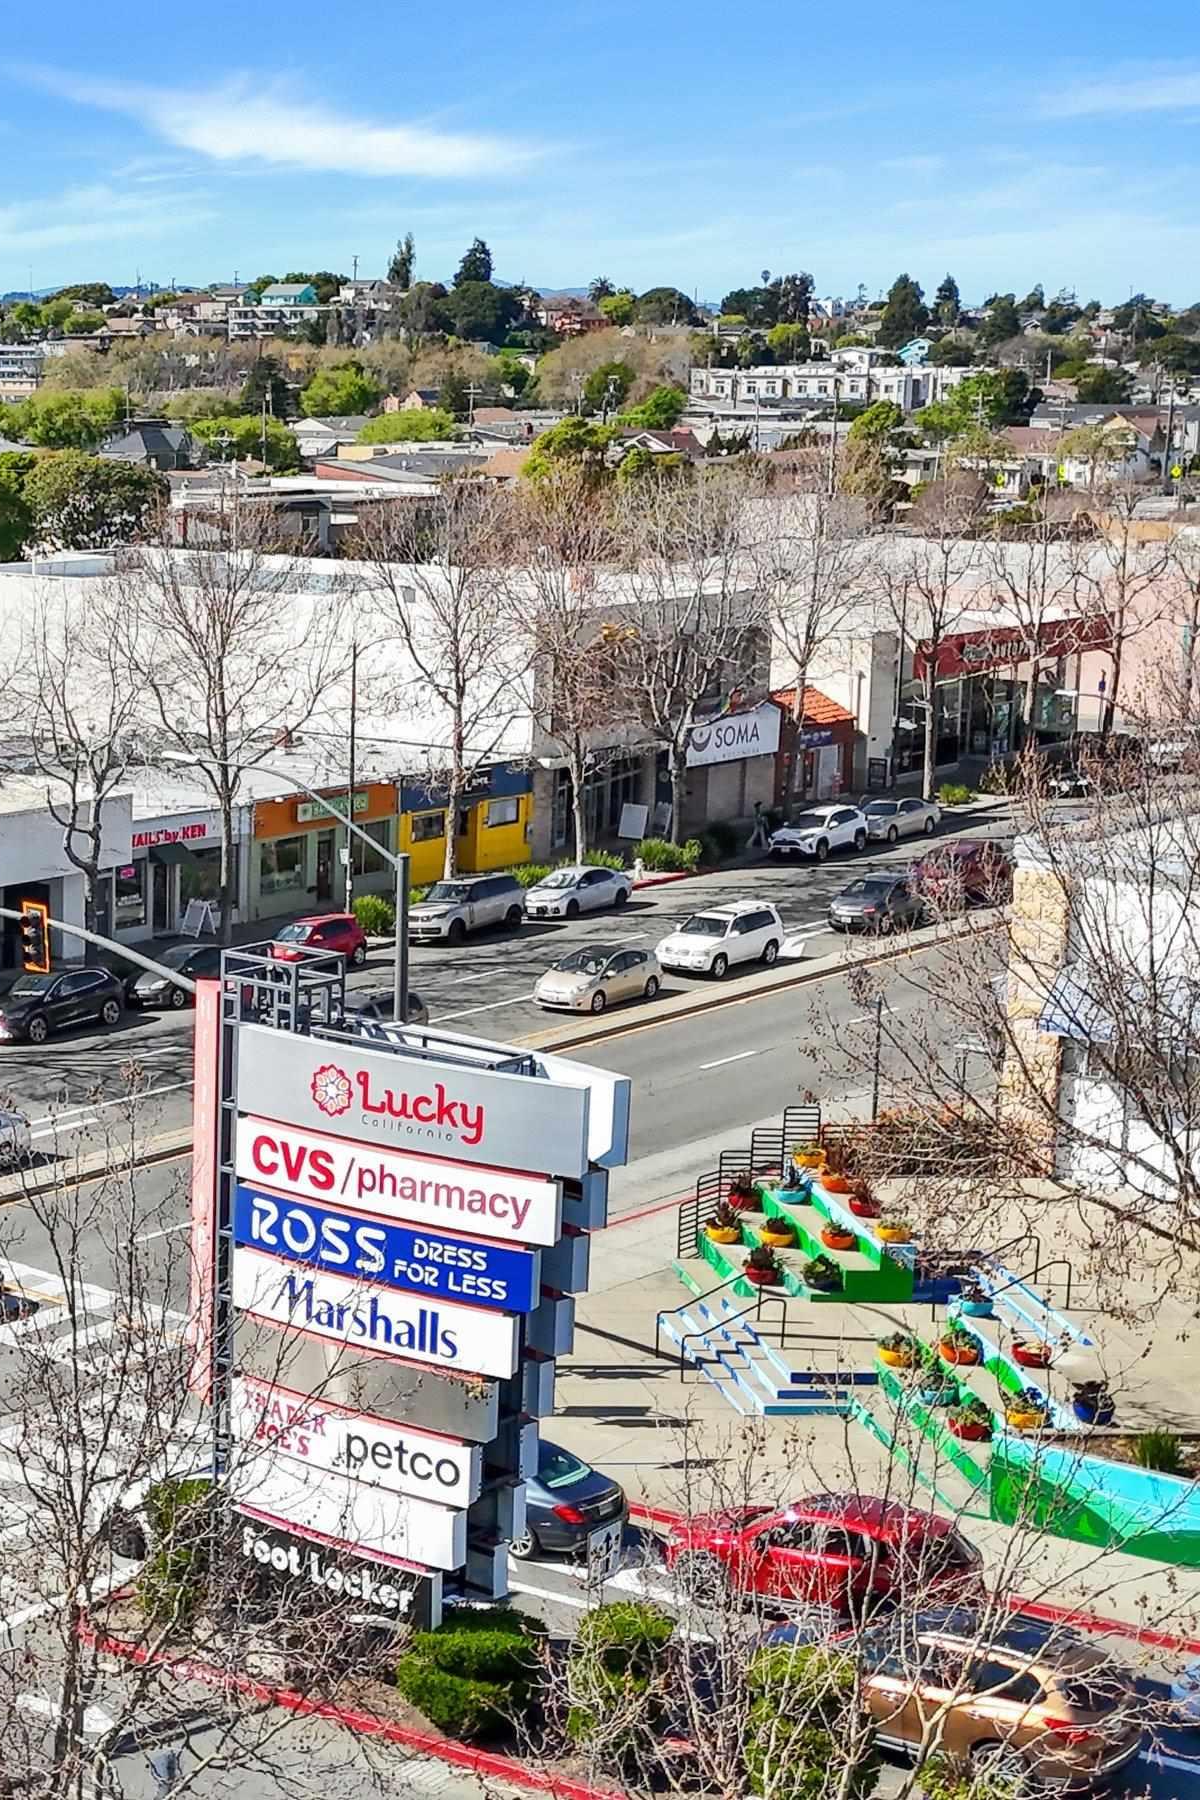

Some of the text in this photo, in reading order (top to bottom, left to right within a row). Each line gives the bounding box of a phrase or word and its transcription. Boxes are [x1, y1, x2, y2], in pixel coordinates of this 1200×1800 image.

[714, 721, 760, 749] SOMA
[182, 823, 207, 840] KEN
[356, 1070, 484, 1145] Lucky
[361, 1113, 453, 1142] California
[251, 1197, 387, 1273] ROSS
[413, 1238, 488, 1272] DRESS
[393, 1259, 508, 1301] FOR LESS
[271, 1271, 458, 1359] Marshalls
[346, 1432, 461, 1487] petco
[310, 1551, 414, 1612] Locker
